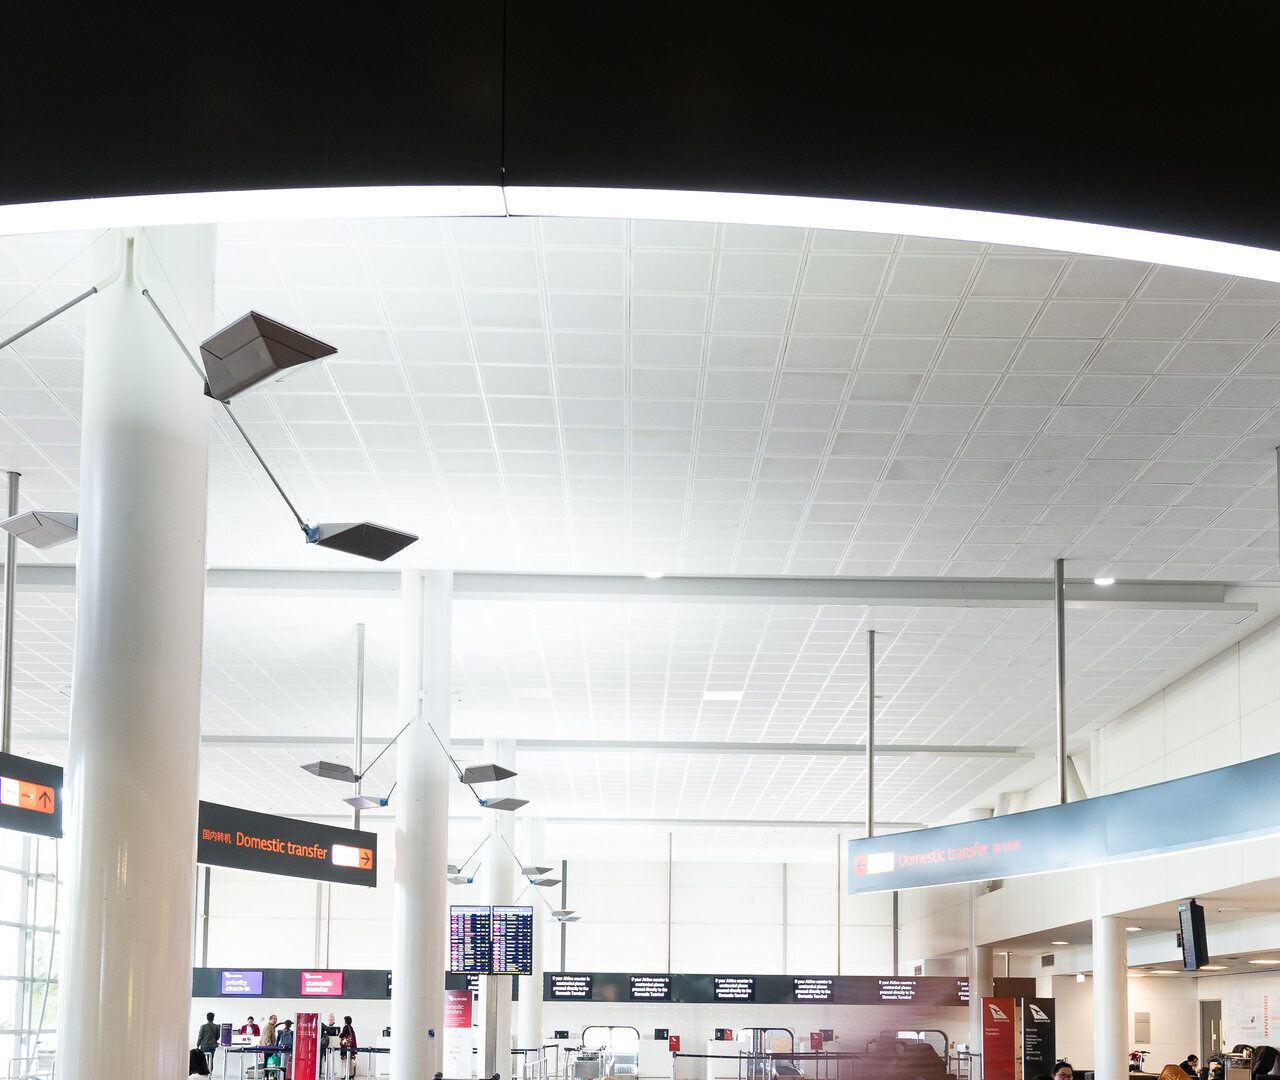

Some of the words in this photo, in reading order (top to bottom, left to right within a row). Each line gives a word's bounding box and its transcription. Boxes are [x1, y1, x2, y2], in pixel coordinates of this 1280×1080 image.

[202, 828, 232, 844] 国内转机
[236, 831, 286, 854] Domestic
[287, 841, 328, 860] transfer
[898, 848, 946, 868] Domestic
[947, 841, 989, 861] transfer
